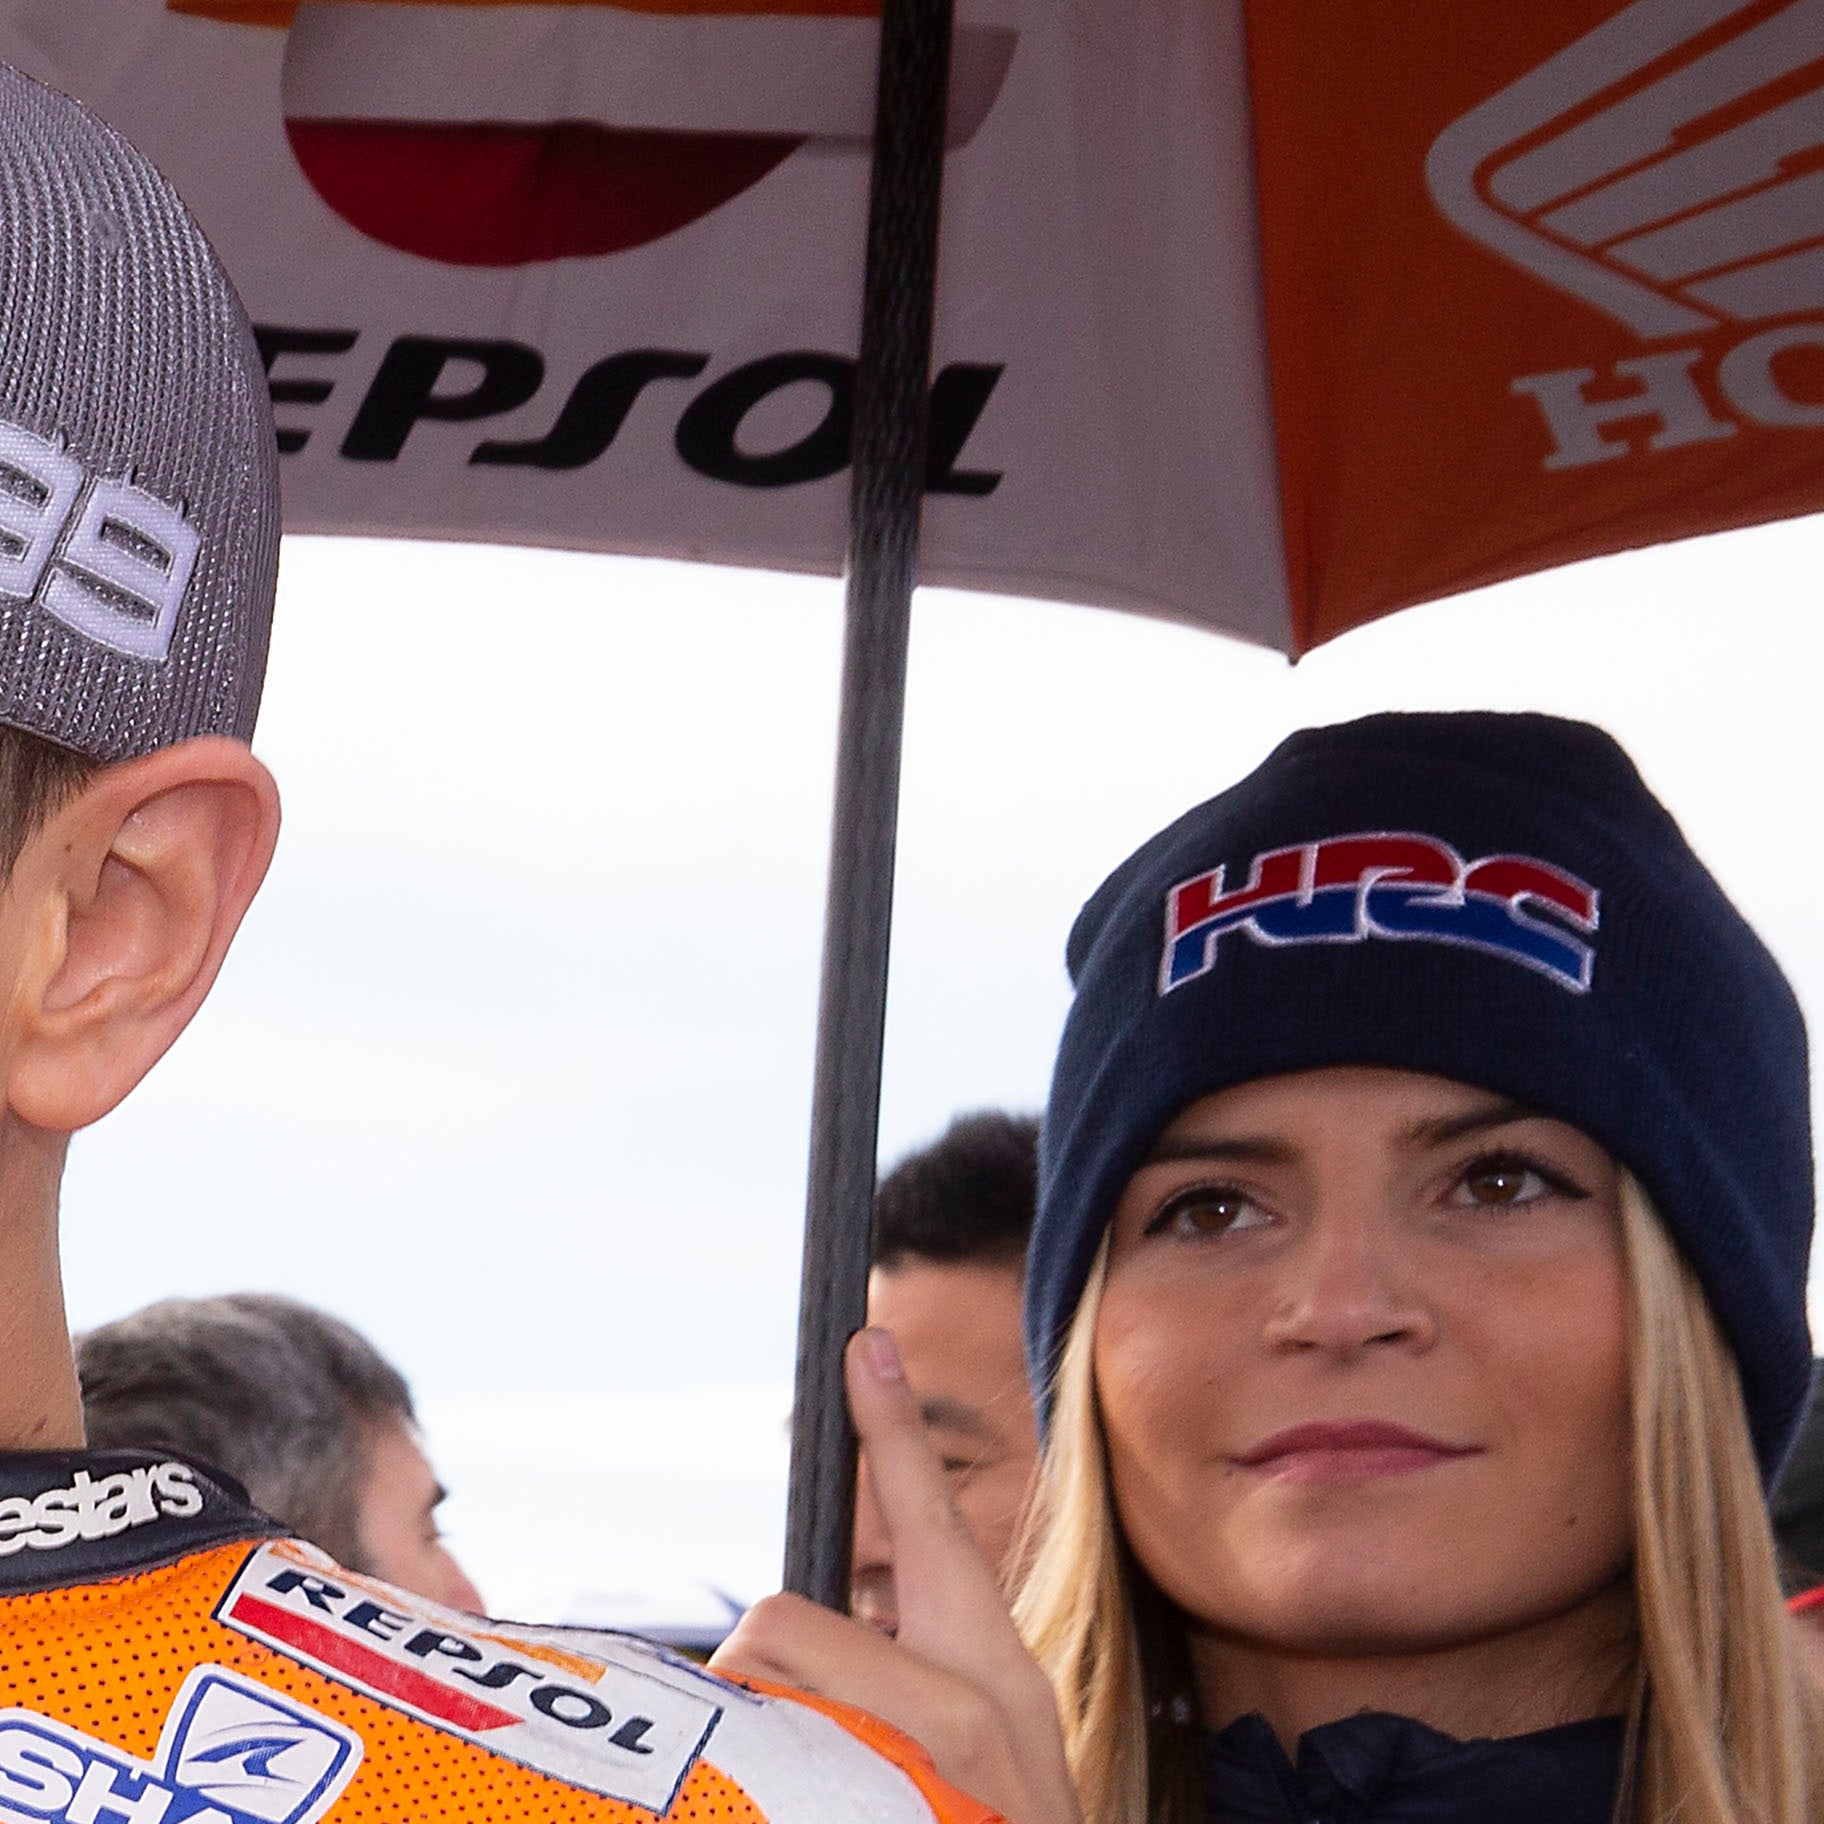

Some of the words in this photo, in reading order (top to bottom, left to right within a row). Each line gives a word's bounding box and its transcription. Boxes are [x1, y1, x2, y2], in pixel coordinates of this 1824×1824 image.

[252, 322, 1006, 498] EPSOL
[1156, 830, 1602, 996] HRC
[263, 1564, 656, 1756] REPSOL
